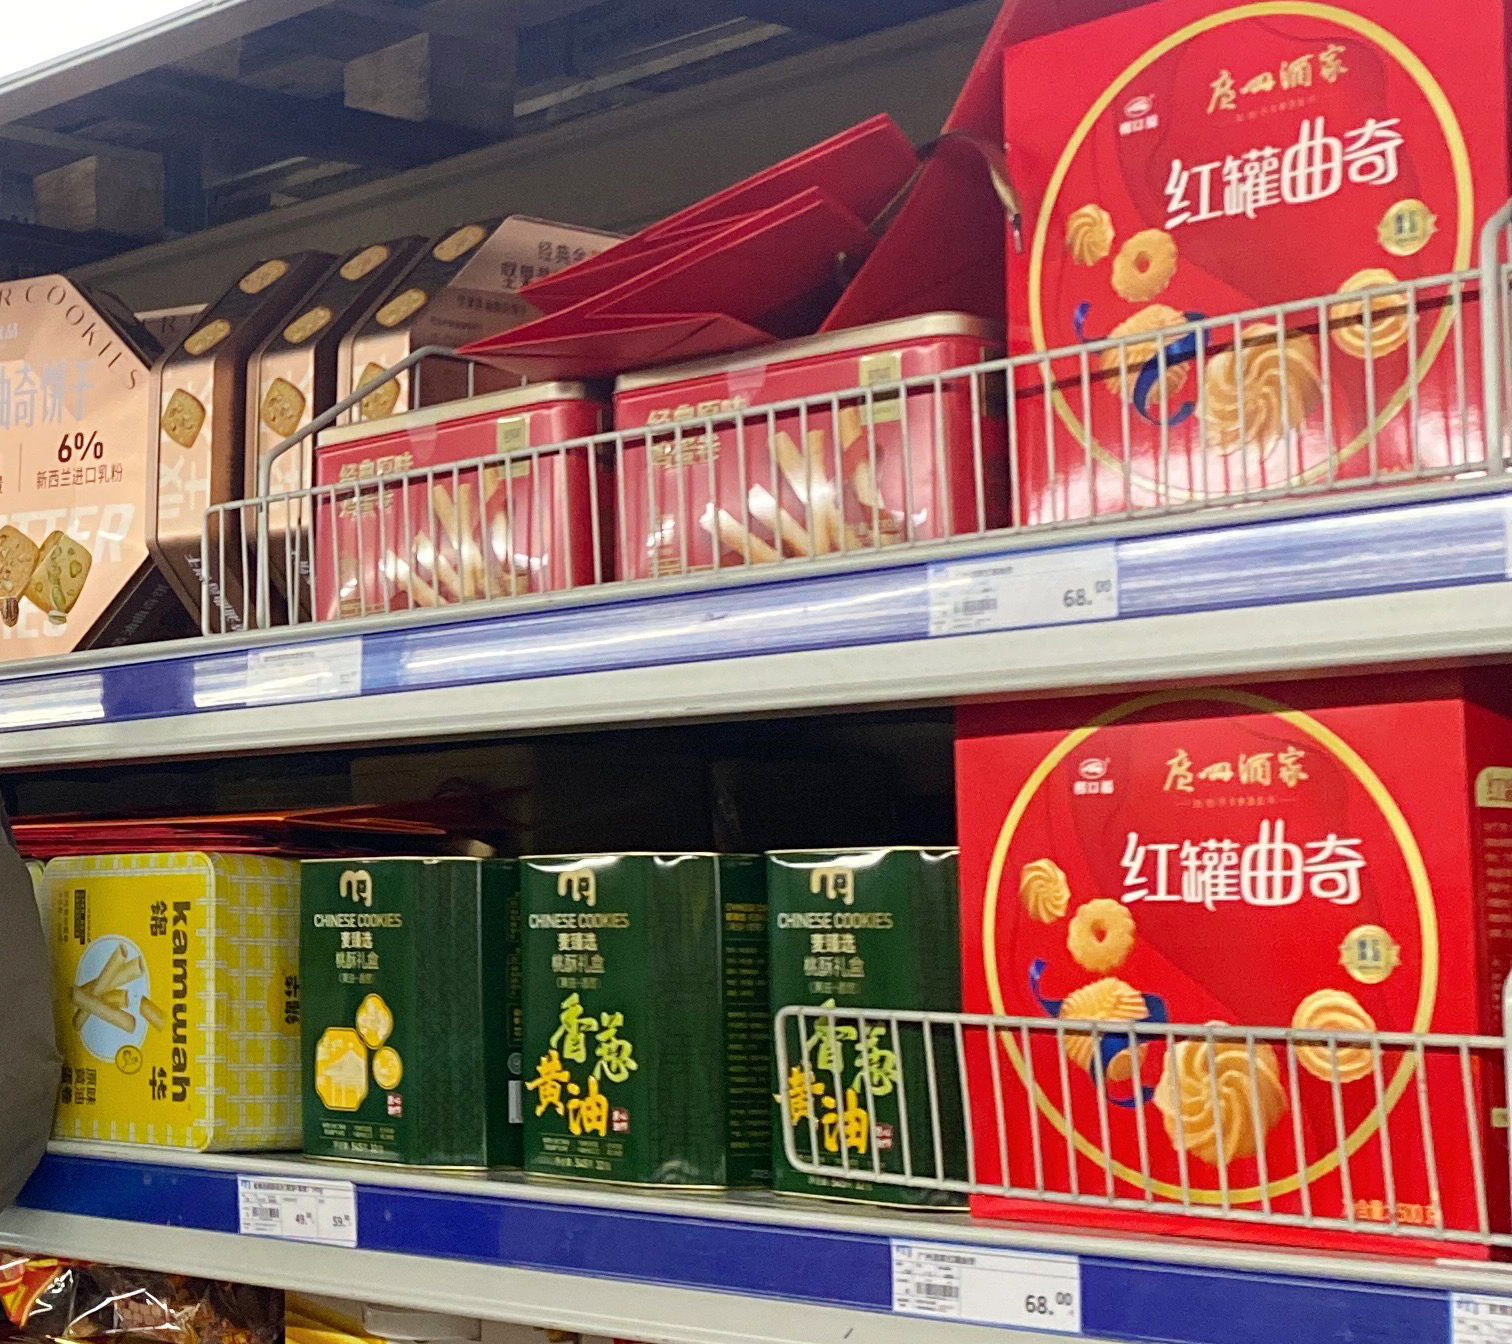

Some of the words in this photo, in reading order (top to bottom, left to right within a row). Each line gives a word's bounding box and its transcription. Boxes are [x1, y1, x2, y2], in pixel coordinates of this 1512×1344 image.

[1164, 116, 1405, 229] 红罐曲奇
[25, 285, 139, 391] COOKIES
[36, 462, 123, 490] 新西兰进口乳粉
[57, 430, 104, 463] 6%
[1121, 818, 1367, 912] 红罐曲奇
[314, 913, 356, 928] CHINESE
[357, 913, 402, 928] COOKIES
[528, 913, 577, 929] CHINESE
[578, 913, 630, 929] COOKIES
[776, 912, 832, 929] CHINESE
[833, 912, 894, 929] COOKIES
[549, 992, 639, 1083] 香葱
[525, 1049, 609, 1137] 黄油
[772, 1065, 869, 1154] 黄油
